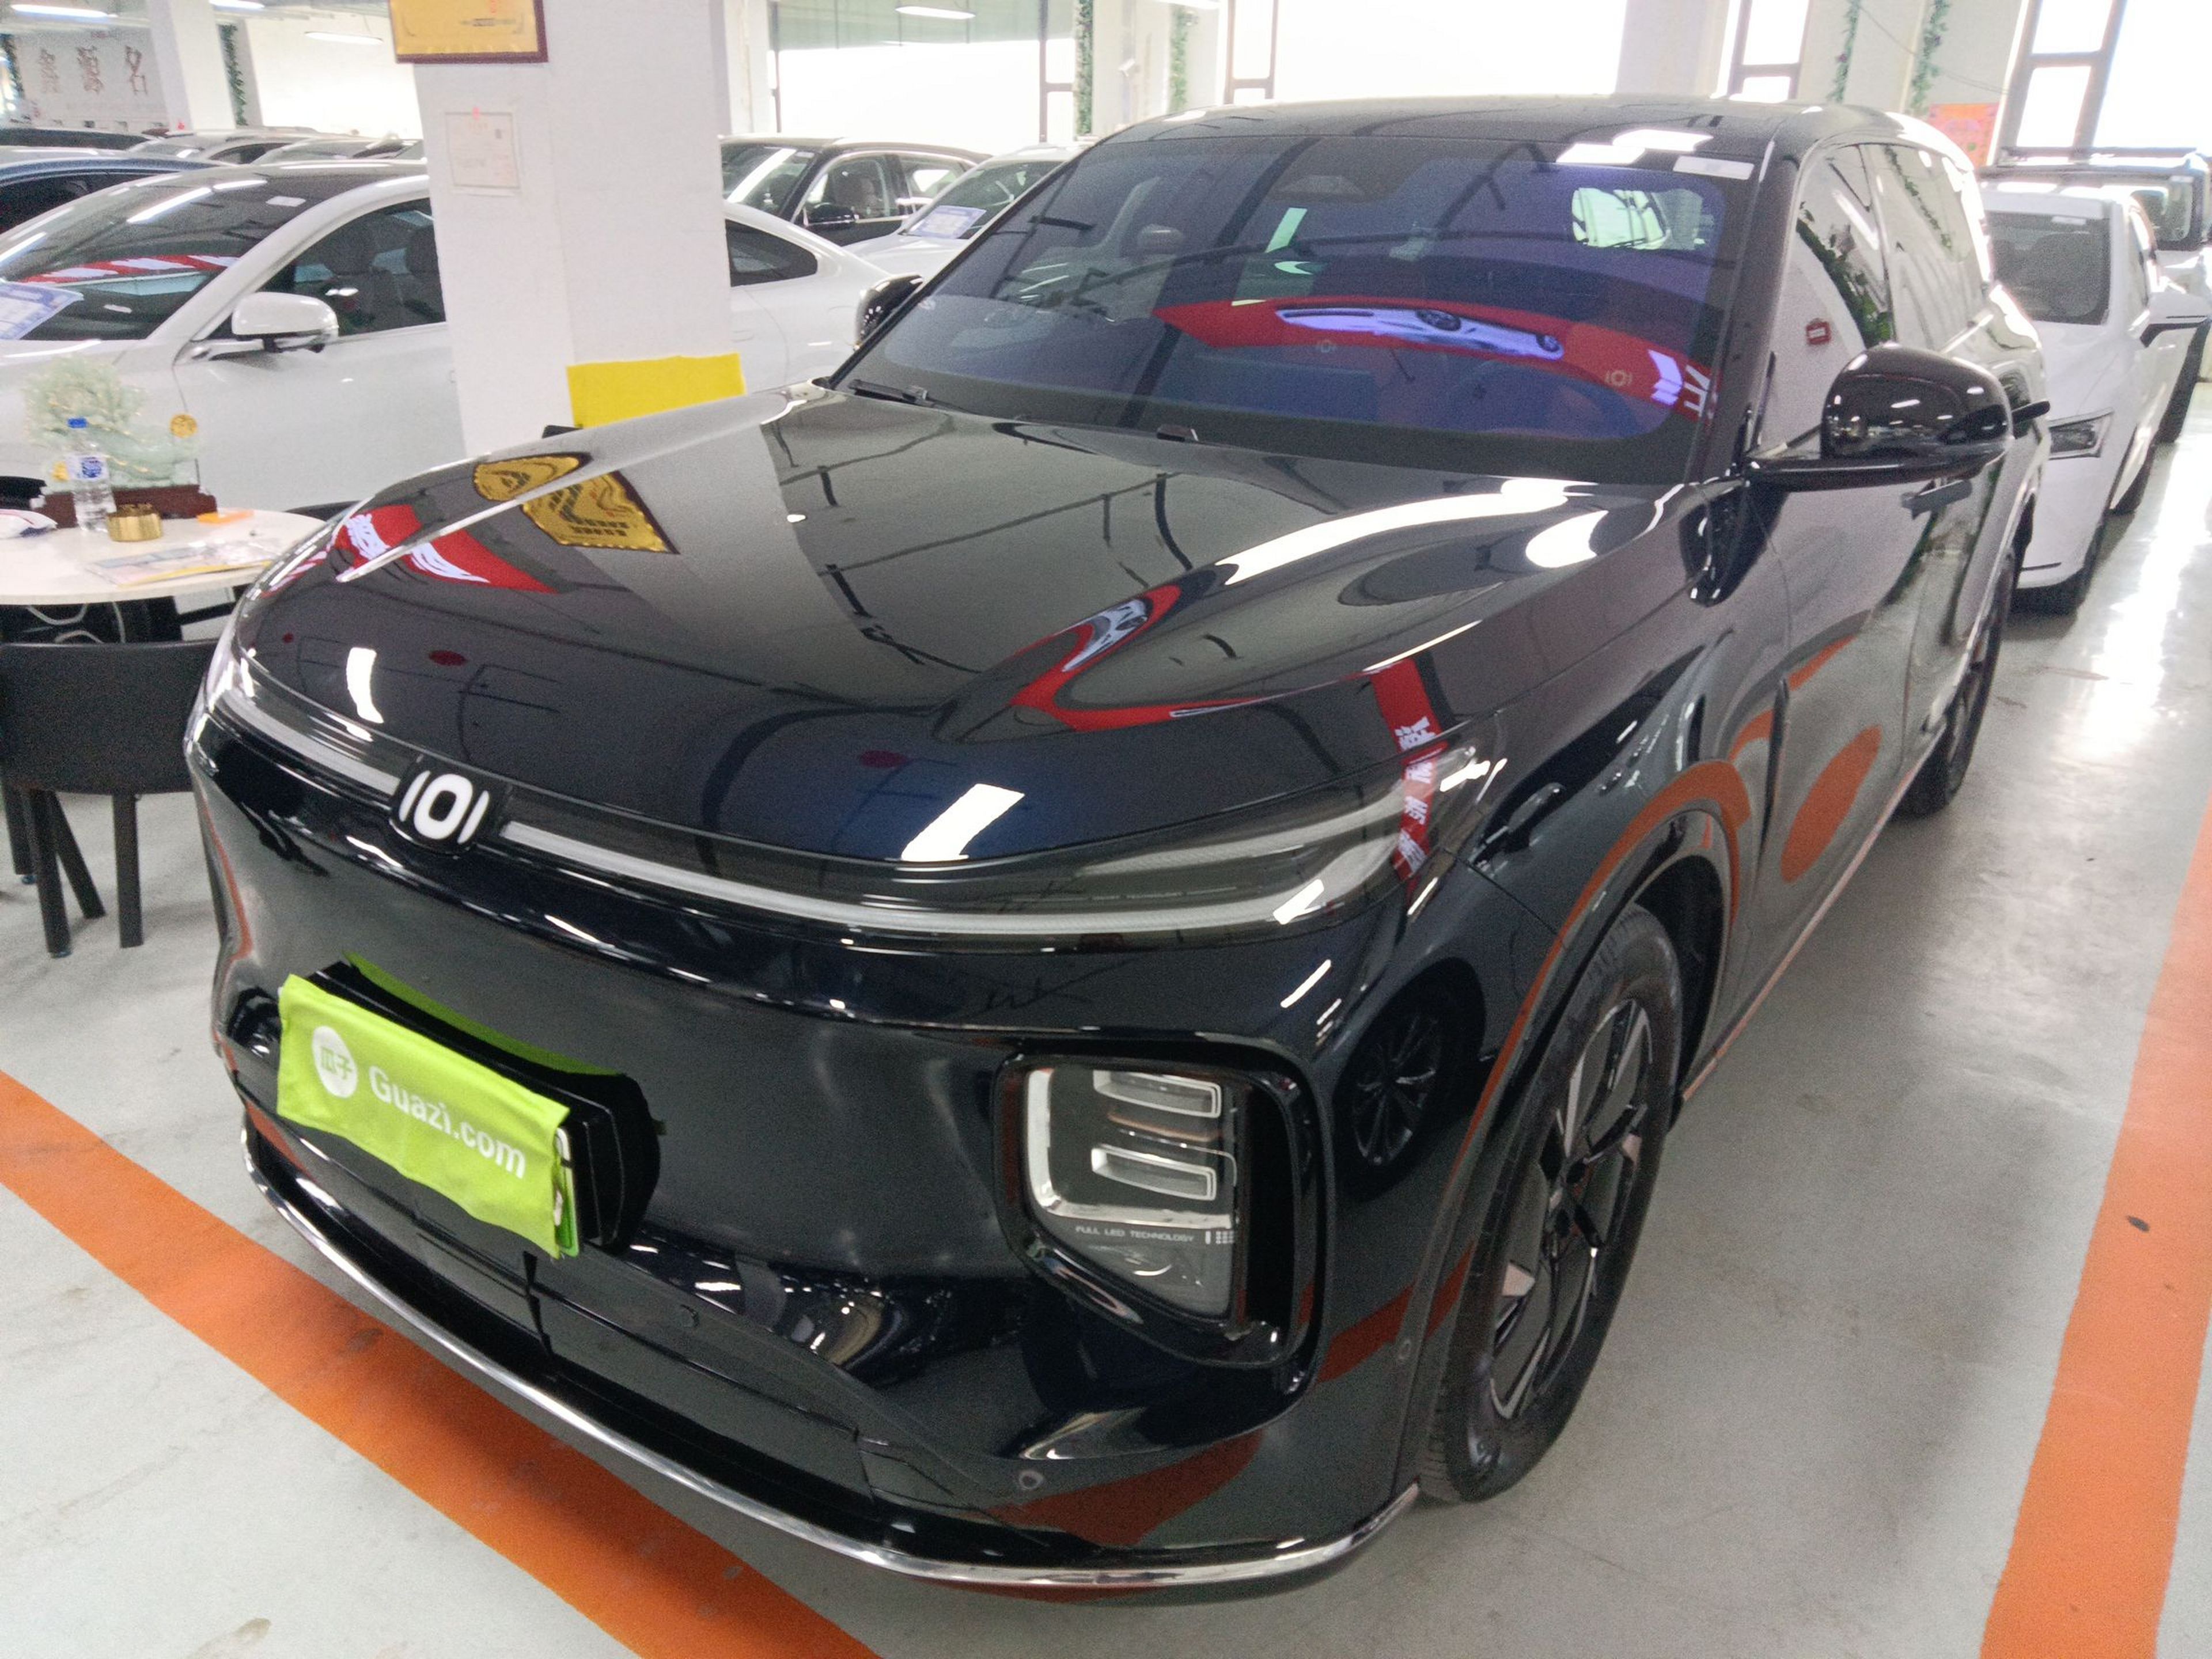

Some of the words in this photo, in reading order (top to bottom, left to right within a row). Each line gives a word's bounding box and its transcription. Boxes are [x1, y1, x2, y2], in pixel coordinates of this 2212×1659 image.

[368, 1065, 525, 1179] Guazi.com
[1075, 1225, 1100, 1235] FULL
[1104, 1228, 1126, 1237] LED
[1130, 1230, 1195, 1242] TECHNOLOGY
